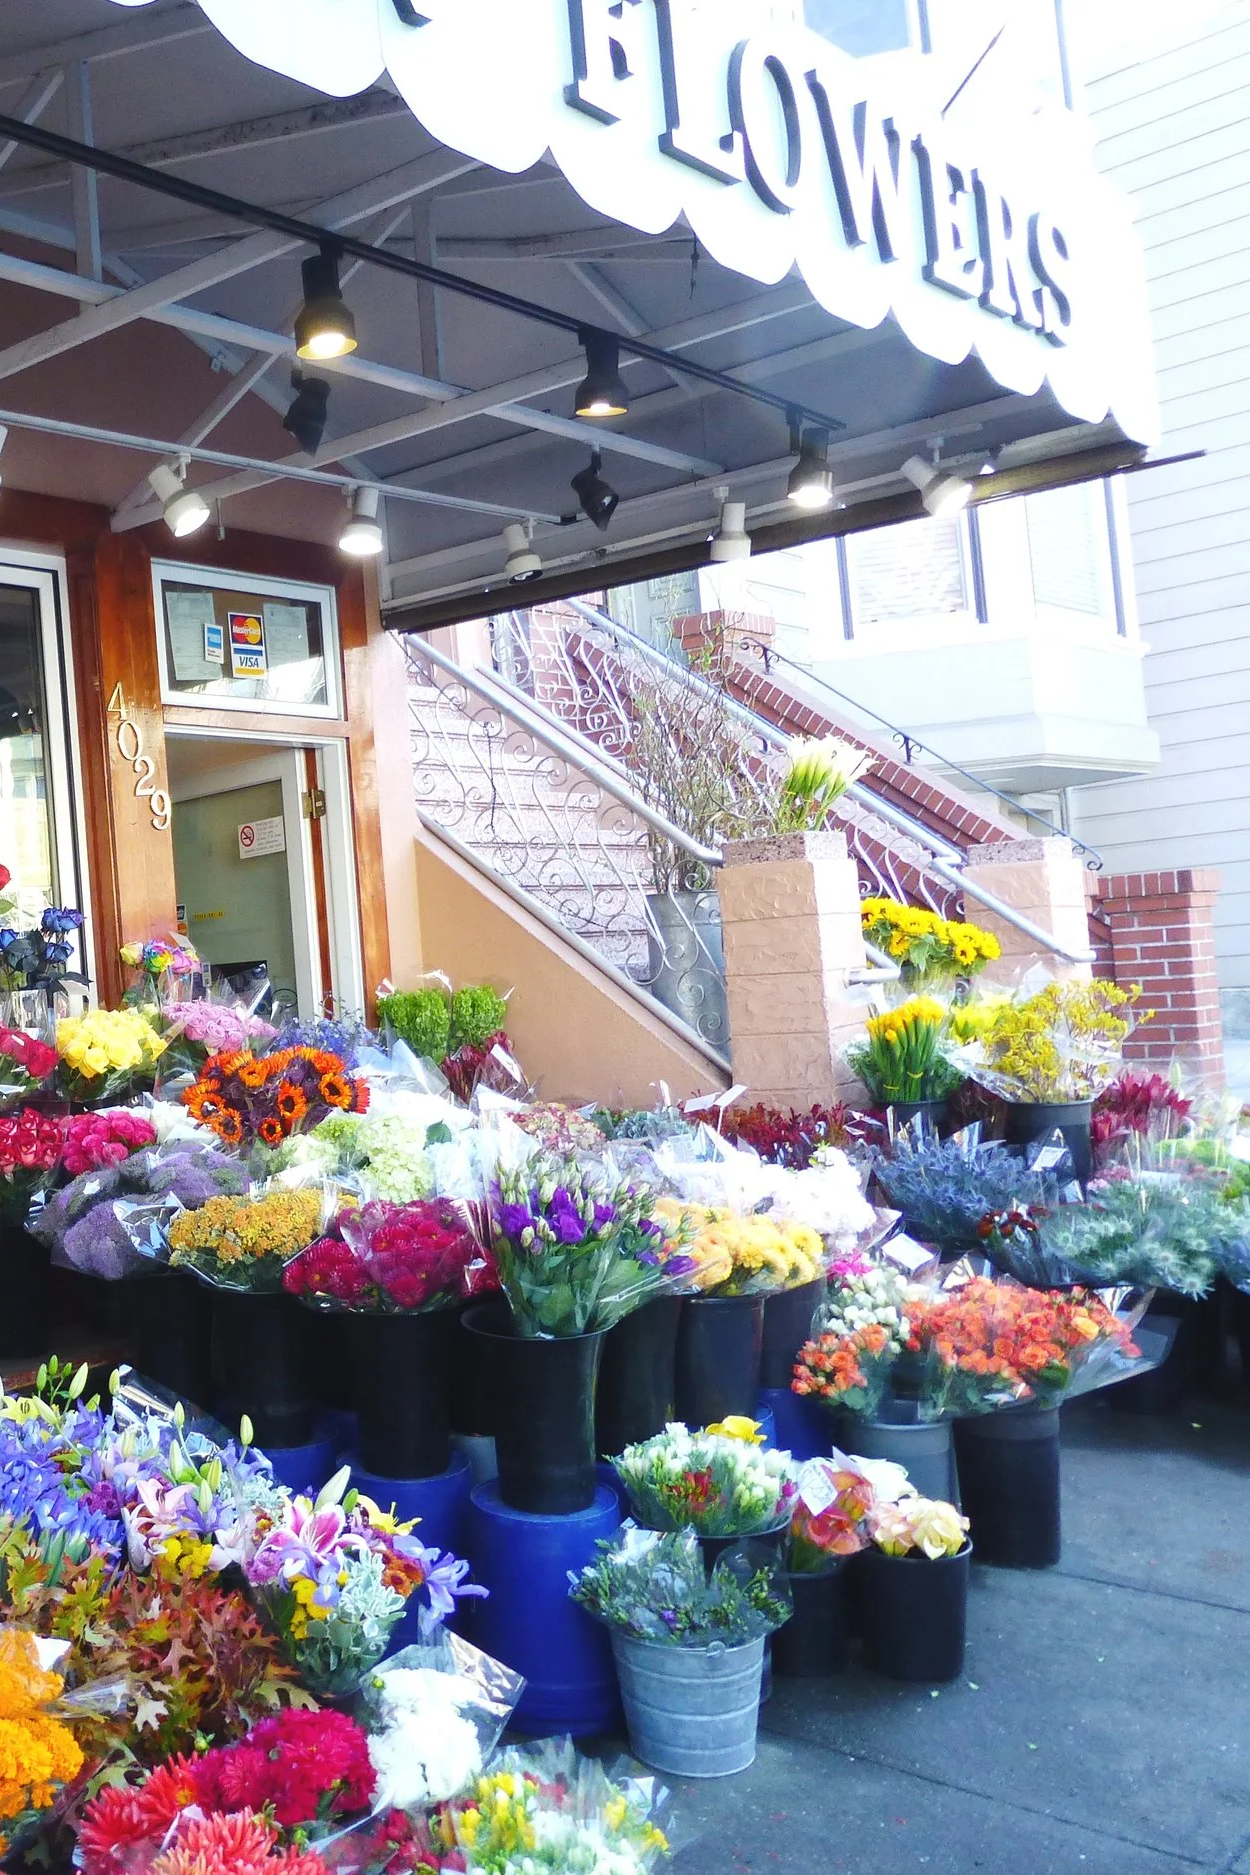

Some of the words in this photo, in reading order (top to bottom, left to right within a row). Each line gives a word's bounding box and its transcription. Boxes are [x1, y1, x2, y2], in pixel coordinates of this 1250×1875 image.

[562, 0, 1072, 348] FLOWERS
[239, 655, 259, 668] VISA
[107, 681, 171, 830] 4029
